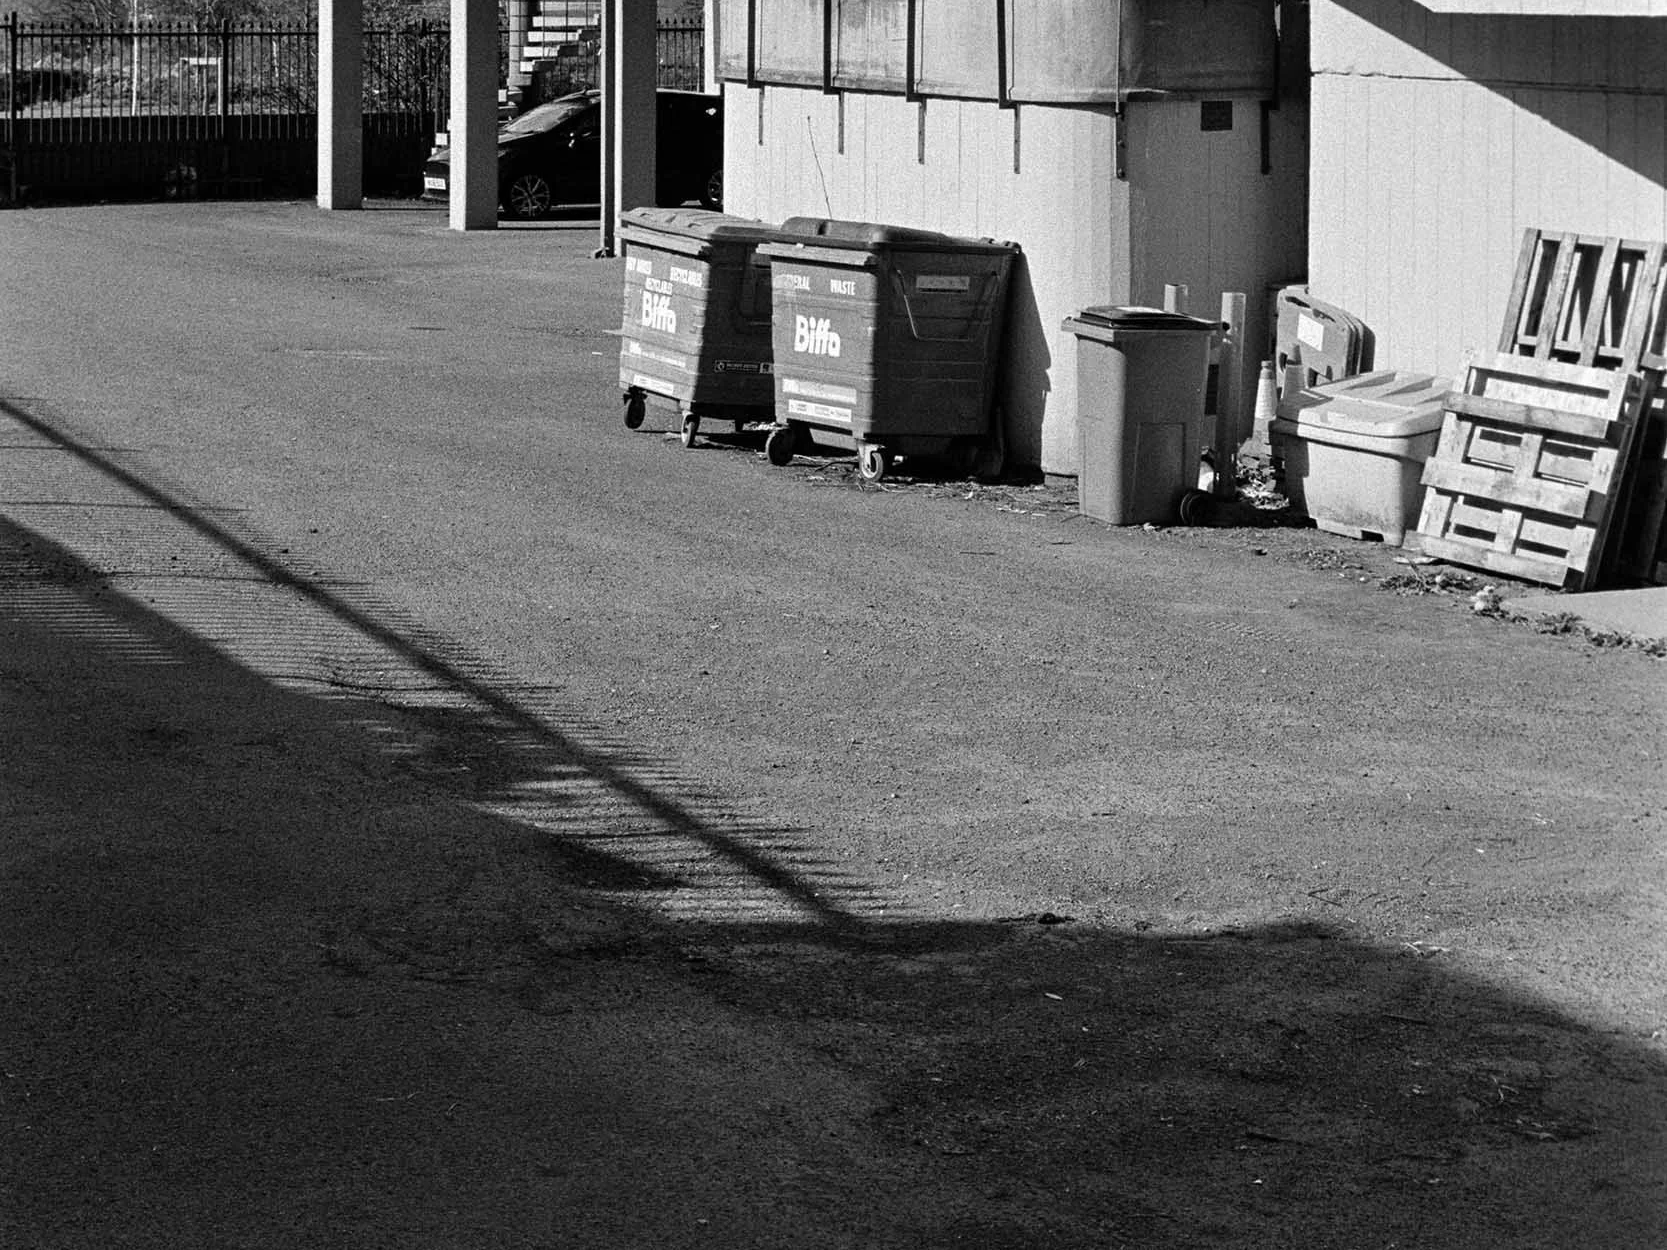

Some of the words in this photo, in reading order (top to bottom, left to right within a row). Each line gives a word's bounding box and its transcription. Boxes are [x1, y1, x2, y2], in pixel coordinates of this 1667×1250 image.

[830, 279, 856, 296] WASTE
[641, 290, 676, 334] Biffa
[794, 314, 841, 357] Biffa
